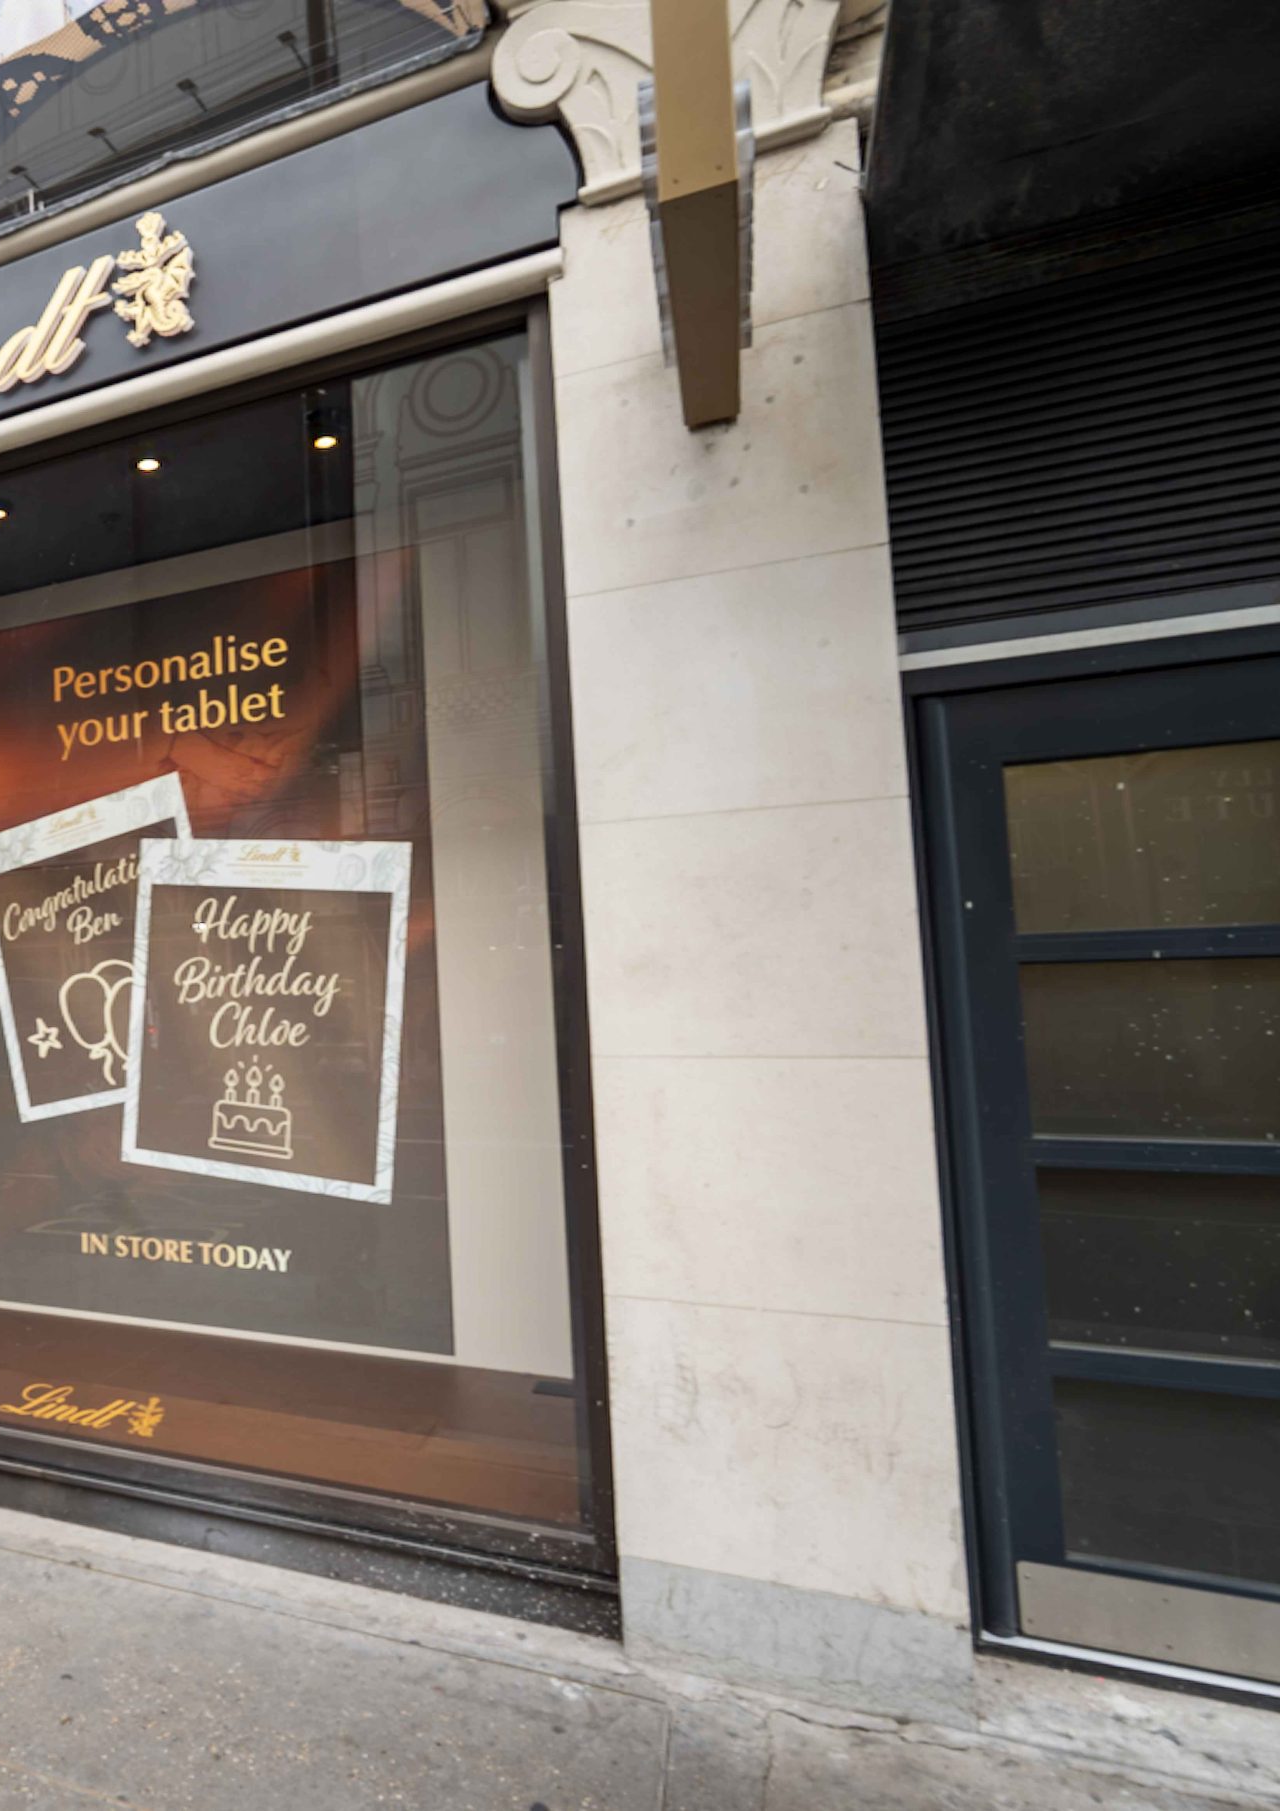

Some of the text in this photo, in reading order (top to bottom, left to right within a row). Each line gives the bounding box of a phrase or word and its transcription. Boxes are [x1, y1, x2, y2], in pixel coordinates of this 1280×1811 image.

[53, 635, 289, 702] Personalise
[56, 683, 286, 761] your tablet
[236, 843, 289, 862] Lindt
[67, 906, 122, 945] Ben
[192, 895, 312, 955] Happy
[173, 955, 341, 1017] Birthday
[209, 1001, 311, 1049] Chloe
[81, 1232, 292, 1273] IN STORE TODAY
